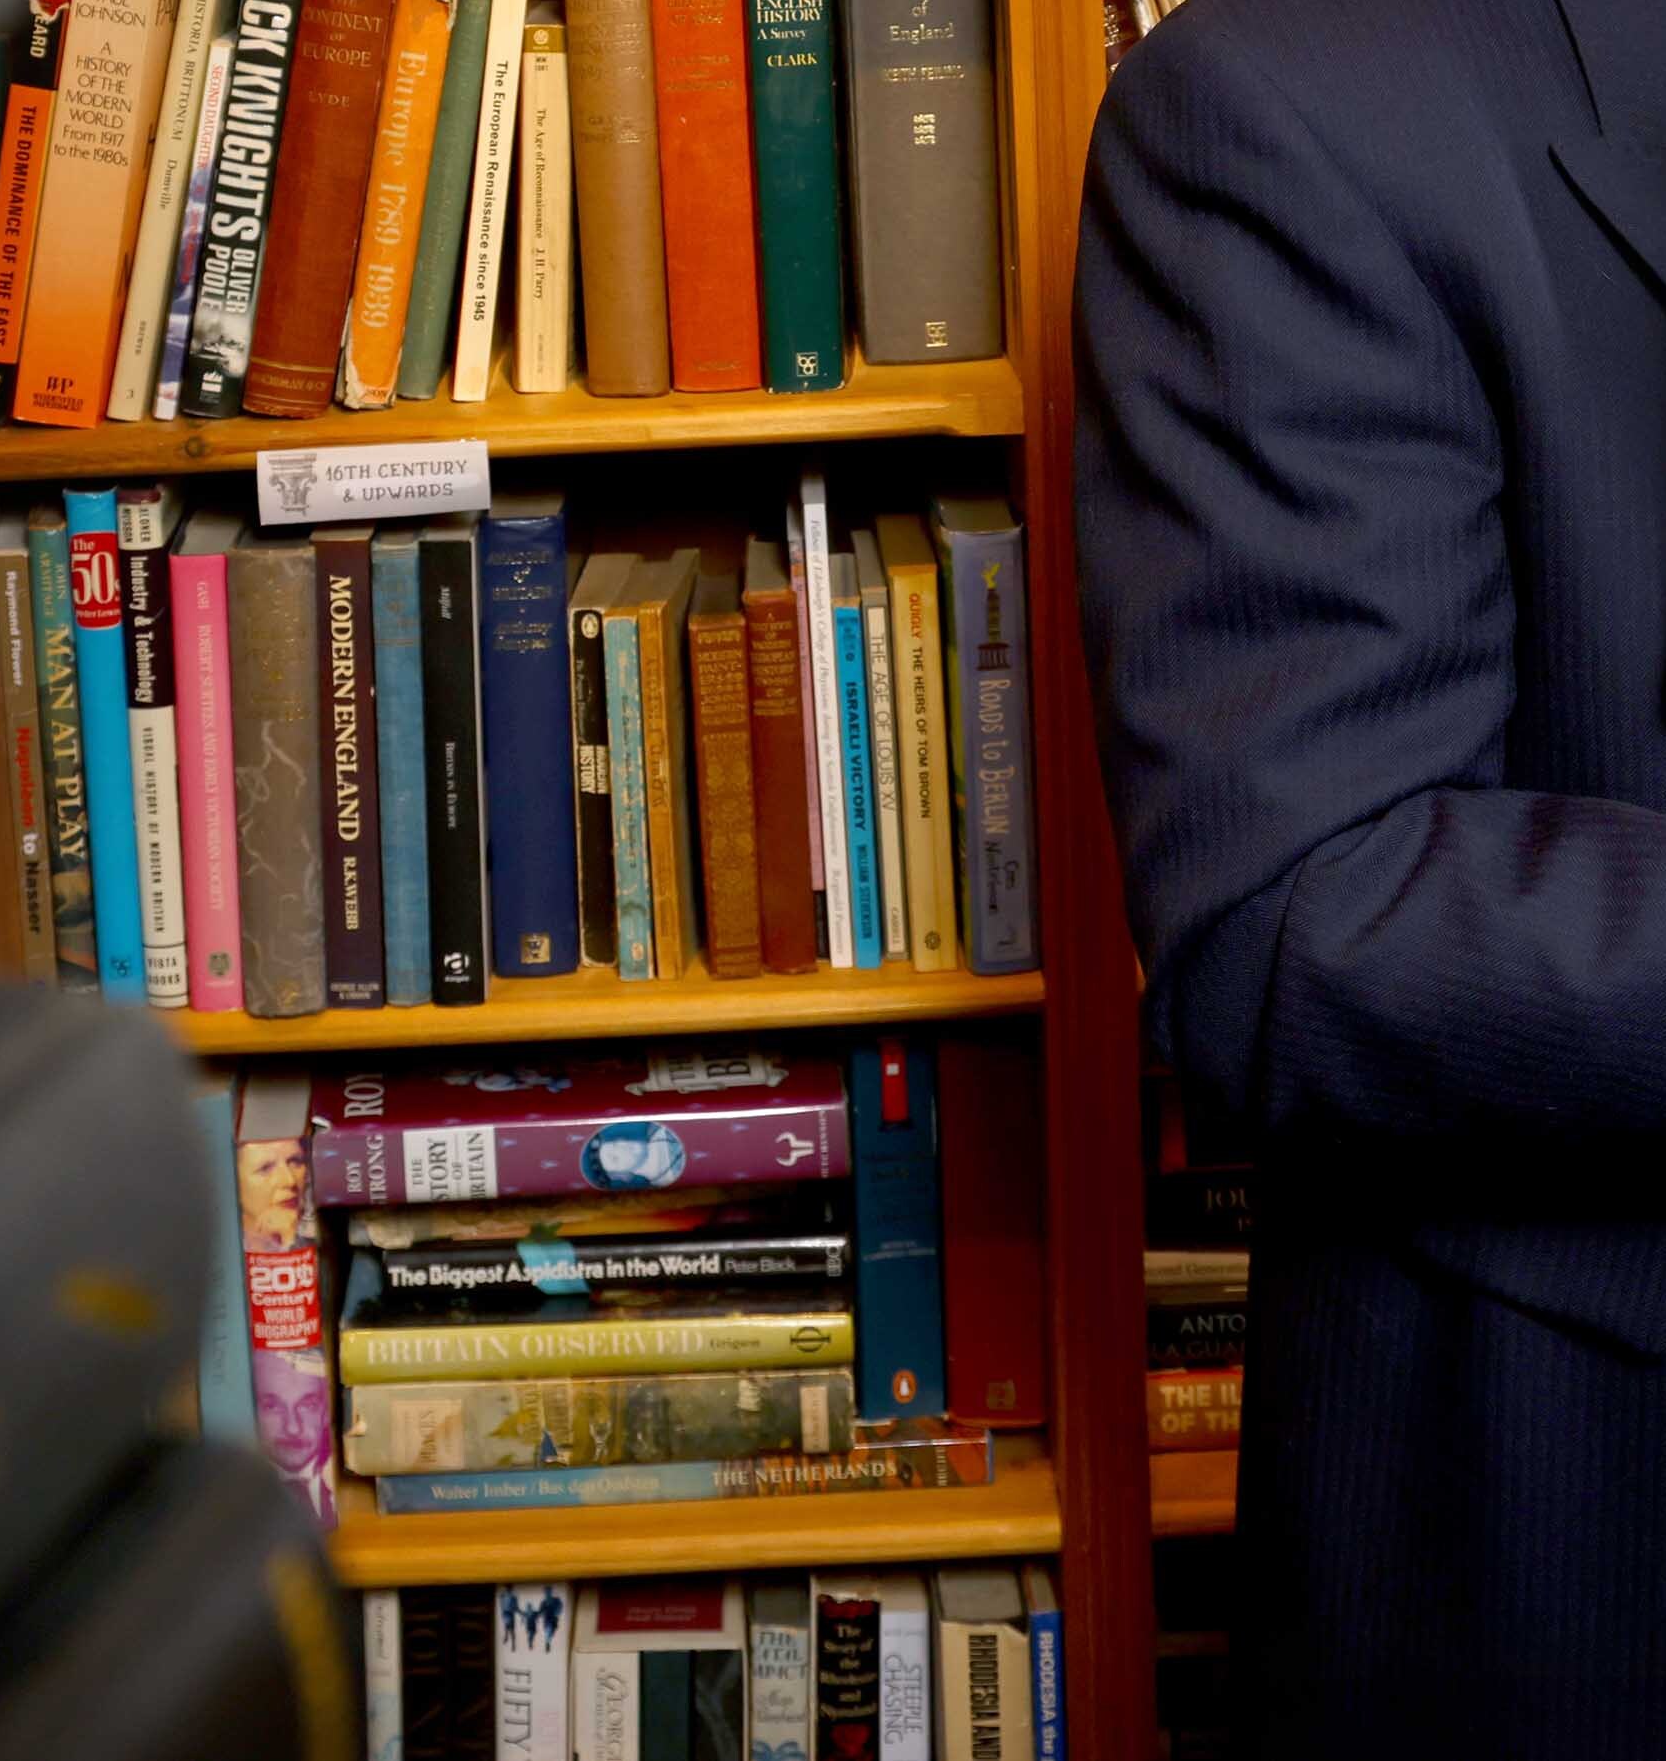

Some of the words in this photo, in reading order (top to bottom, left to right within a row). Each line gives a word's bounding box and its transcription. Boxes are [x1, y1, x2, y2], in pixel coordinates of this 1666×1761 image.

[75, 5, 146, 26] JOHNSON
[757, 7, 823, 23] HISTORY
[75, 56, 132, 74] HISTORY
[494, 60, 509, 88] The
[767, 52, 818, 66] CLARK
[64, 91, 133, 112] MODERN
[20, 106, 38, 140] THE
[69, 110, 125, 129] WORLD
[486, 92, 507, 158] European
[210, 60, 285, 243] KNIGHTS
[5, 142, 35, 237] DOMINANCE
[479, 161, 500, 249] Renaissance
[1, 238, 19, 264] OF
[201, 243, 231, 315] POOLE
[226, 246, 257, 315] OLIVER
[477, 254, 489, 288] since
[473, 293, 486, 322] 1945
[325, 461, 374, 482] 16TH
[380, 459, 467, 479] CENTURY
[343, 485, 356, 503] &
[362, 480, 454, 501] UPWARDS
[328, 575, 358, 710] MODERN
[845, 682, 861, 753] ISRAELI
[334, 712, 362, 842] ENGLAND
[849, 756, 866, 832] VICTORY
[389, 1267, 425, 1288] The
[429, 1264, 501, 1289] Biggest
[605, 1262, 622, 1279] in
[626, 1259, 657, 1279] the
[660, 1255, 720, 1278] World
[366, 1334, 508, 1364] BRITAIN
[521, 1330, 705, 1358] OBSERVED
